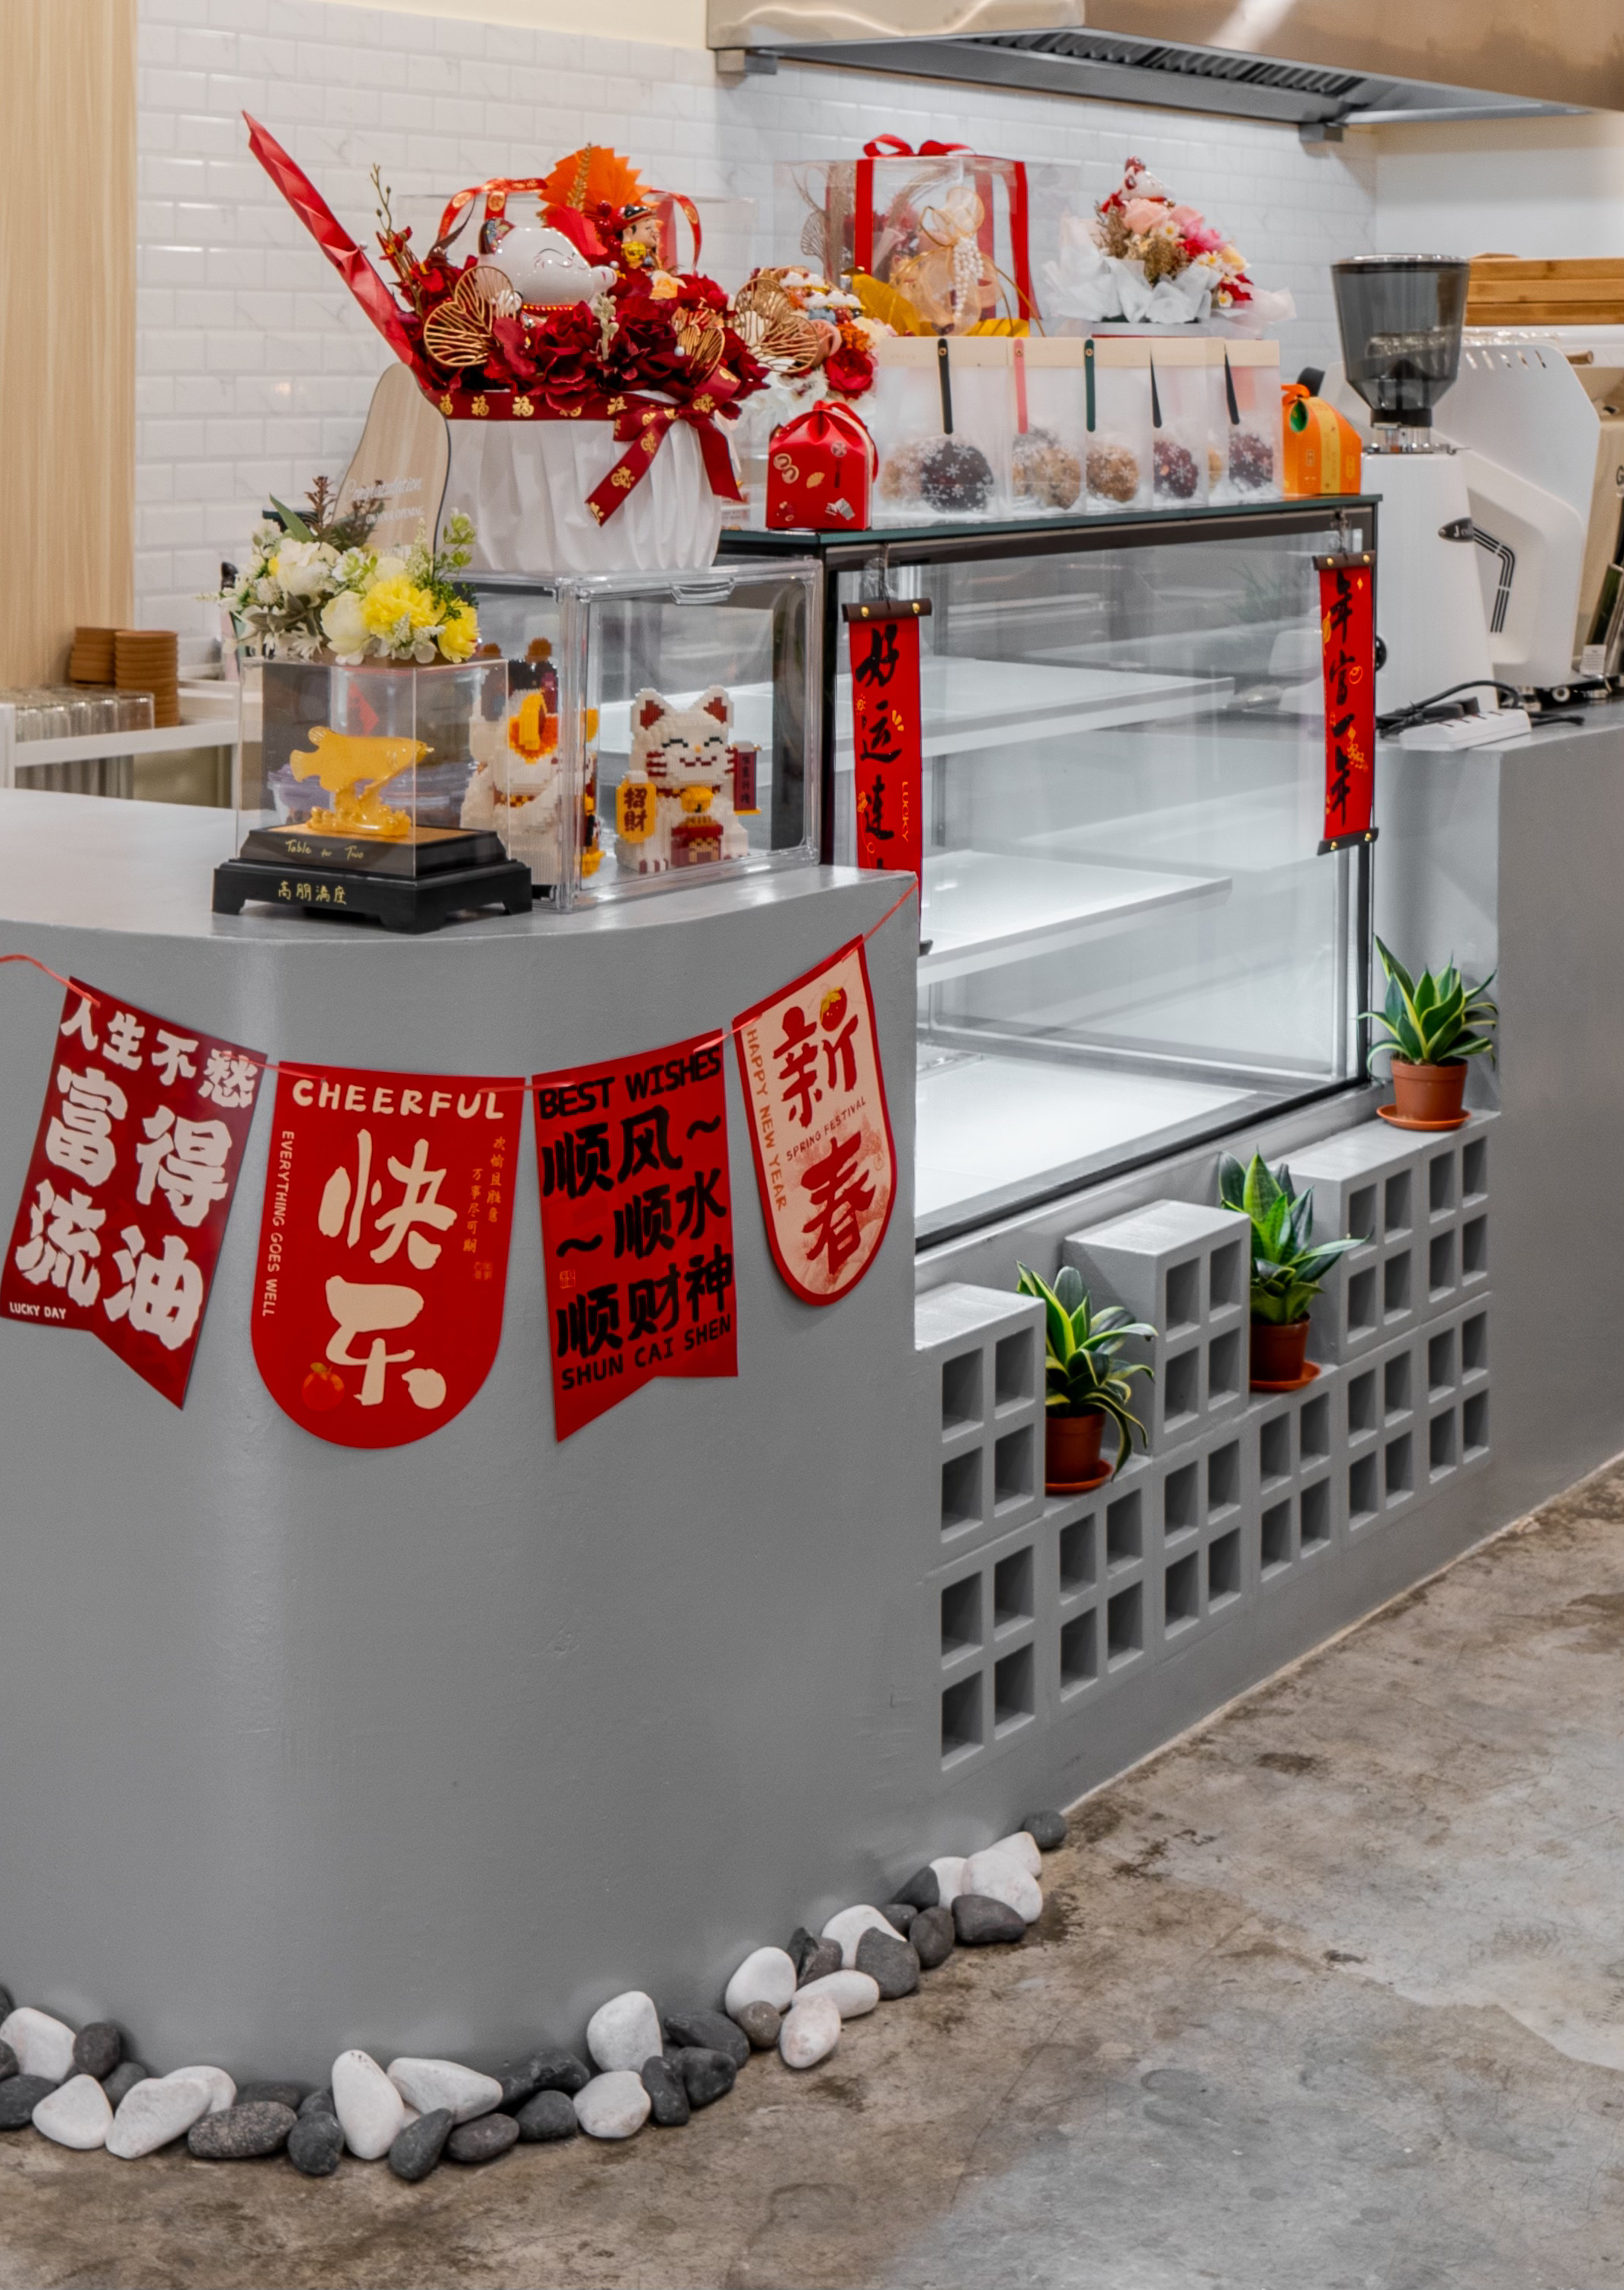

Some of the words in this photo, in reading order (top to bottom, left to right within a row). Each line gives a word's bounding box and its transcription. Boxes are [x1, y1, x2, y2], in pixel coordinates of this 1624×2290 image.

[286, 839, 311, 855] Table
[345, 846, 364, 860] Two
[60, 995, 258, 1109] 人生不愁
[538, 1076, 616, 1120] BEST
[625, 1045, 721, 1103] WISHES
[292, 1080, 505, 1120] CHEERFUL
[746, 1028, 769, 1097] HAPPY
[759, 1106, 775, 1149] NEW
[767, 1151, 788, 1212] YEAR
[772, 1005, 877, 1276] 新春
[786, 1131, 822, 1161] SPRING
[823, 1096, 867, 1136] FESTIVAL
[45, 1065, 232, 1228] 富得
[271, 1129, 295, 1227] EVERYTHING
[14, 1178, 204, 1351] 流油
[267, 1232, 284, 1273] GOES
[317, 1128, 458, 1410] 快乐
[9, 1301, 40, 1318] LUCKY
[44, 1304, 67, 1321] DAY
[262, 1277, 278, 1317] WELL
[556, 1244, 733, 1359] 顺财神
[562, 1354, 624, 1390] SHUN
[634, 1337, 675, 1368] CAI
[685, 1314, 732, 1352] SHEN
